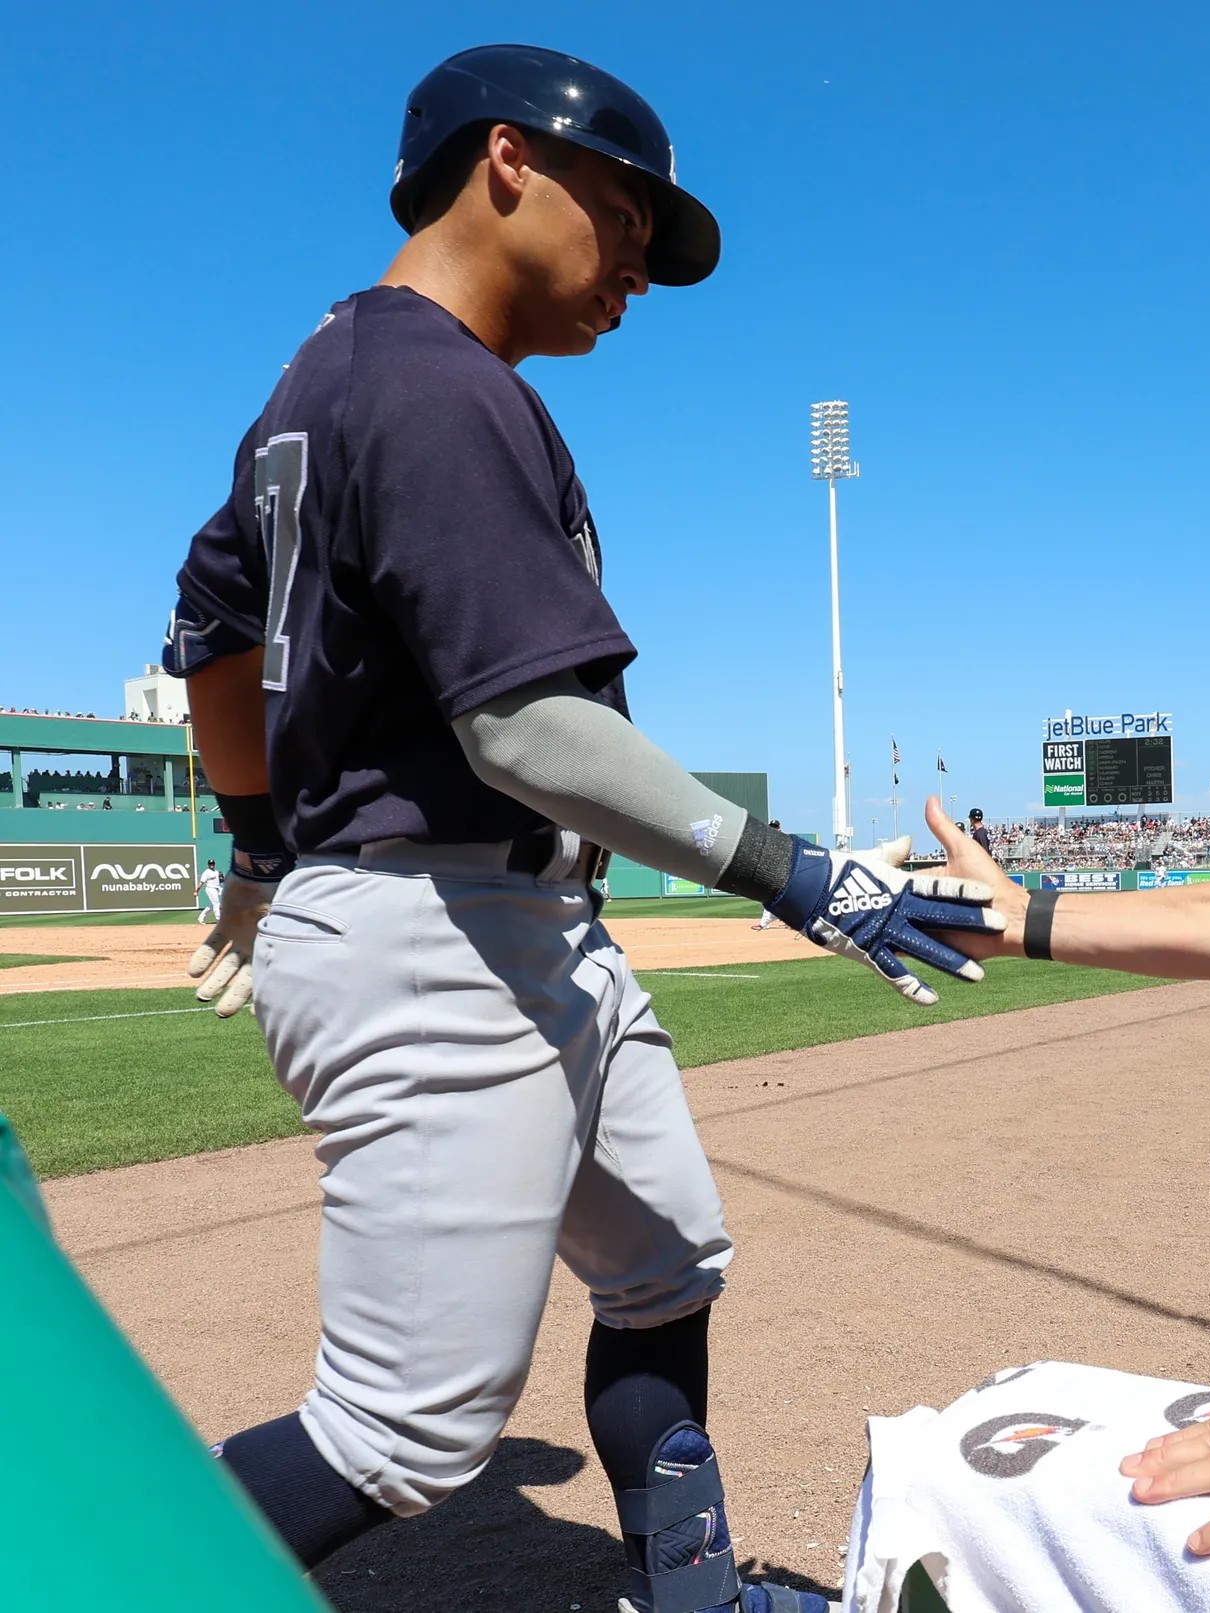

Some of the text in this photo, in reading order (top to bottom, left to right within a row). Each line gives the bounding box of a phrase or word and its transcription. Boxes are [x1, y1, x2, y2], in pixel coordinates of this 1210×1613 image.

[1045, 712, 1169, 741] jetBlue Park
[1047, 744, 1079, 758] FIRST
[1045, 758, 1081, 771] WATCH
[1053, 784, 1084, 793] National
[700, 814, 723, 857] adidas
[90, 863, 190, 880] nuna
[1064, 874, 1117, 882] BEST
[101, 882, 182, 892] nunababy.com
[828, 893, 893, 916] adidas
